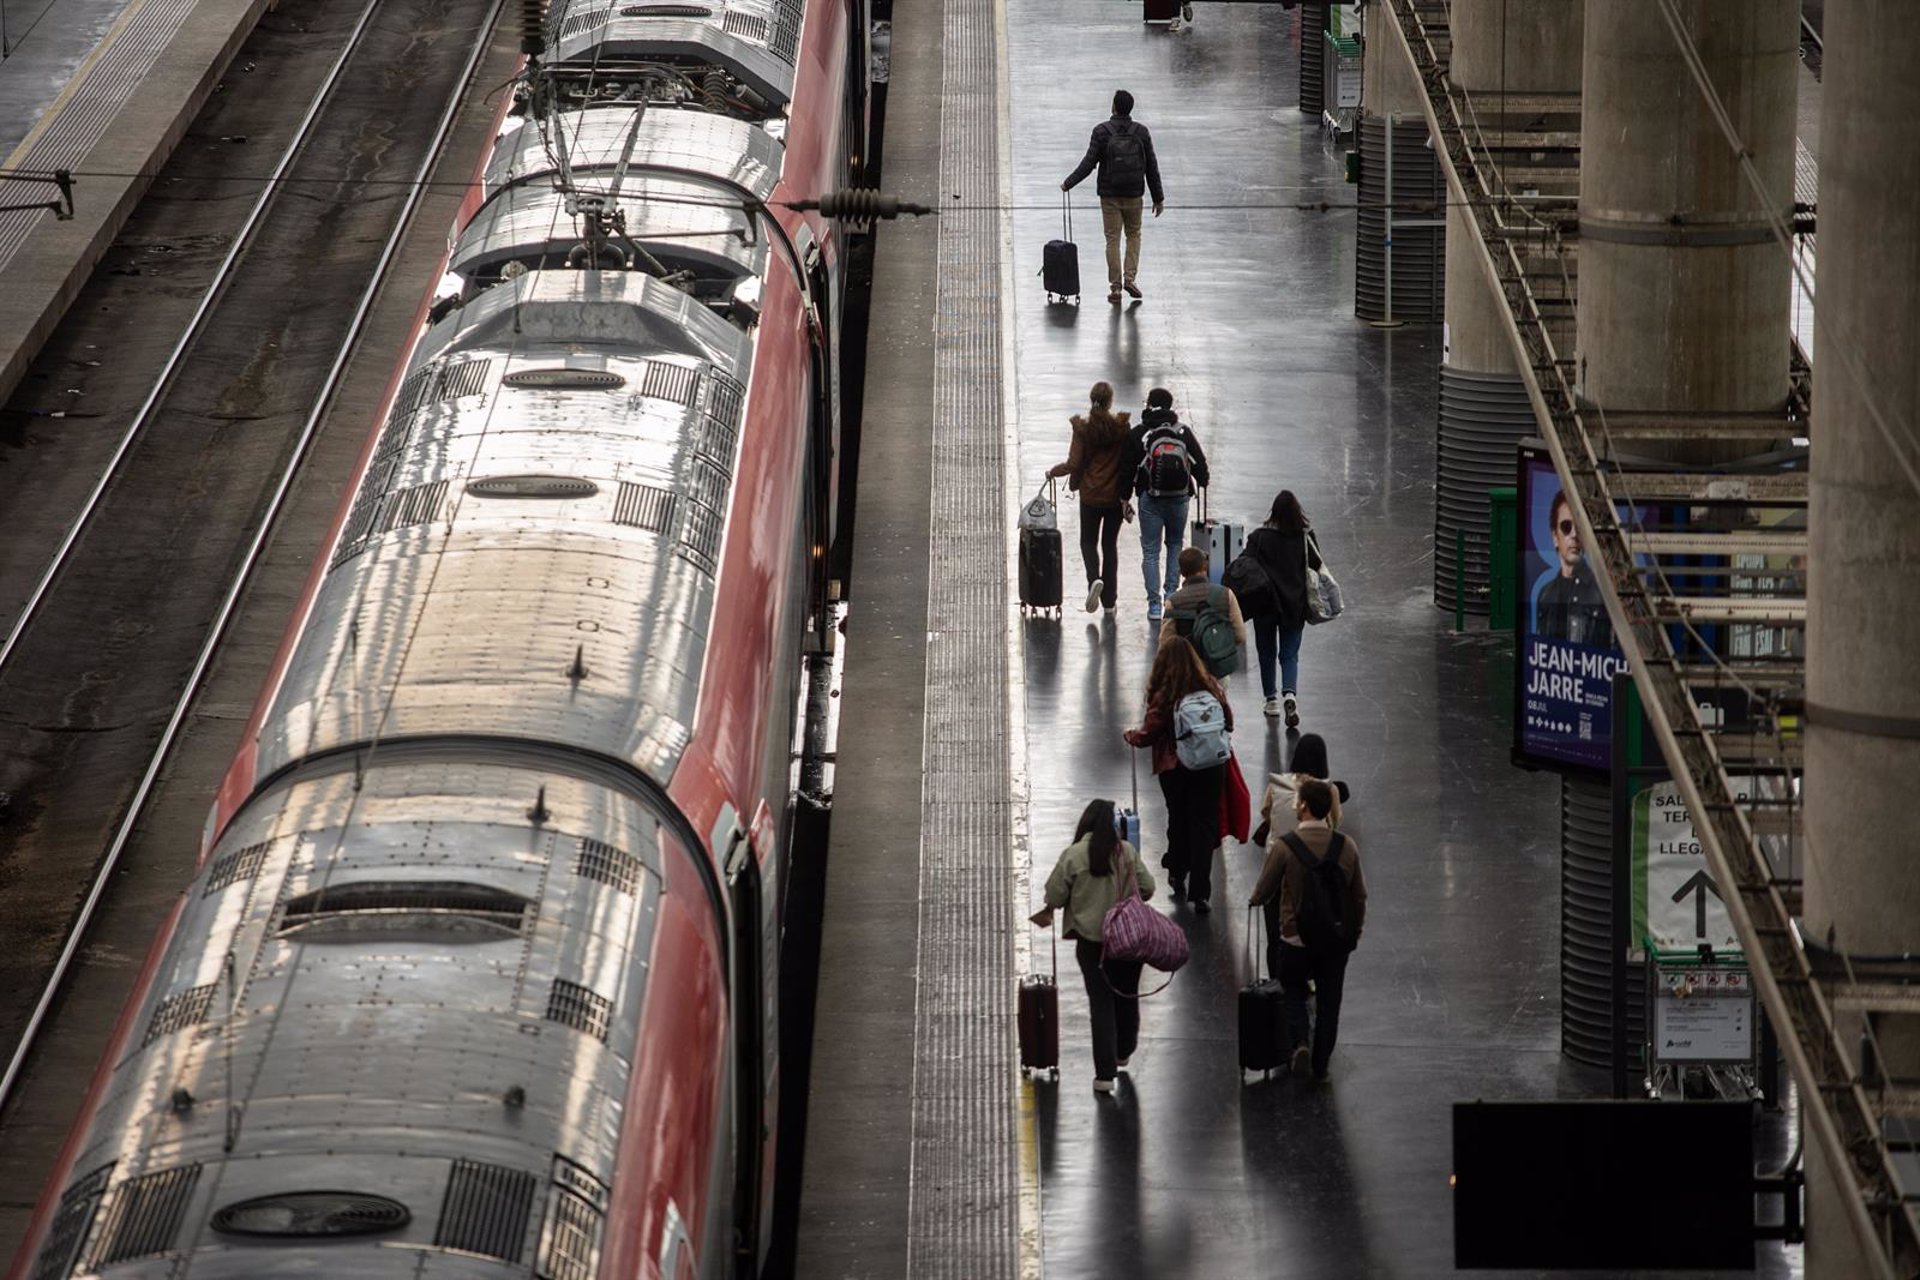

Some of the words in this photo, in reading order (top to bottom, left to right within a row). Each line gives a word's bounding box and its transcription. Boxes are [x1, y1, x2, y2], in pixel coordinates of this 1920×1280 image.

[1528, 642, 1631, 682] JEAN-MICH
[1527, 670, 1583, 704] JARRE
[1655, 794, 1686, 807] SAL
[1663, 811, 1692, 823] TER
[1660, 842, 1704, 855] LLEG
